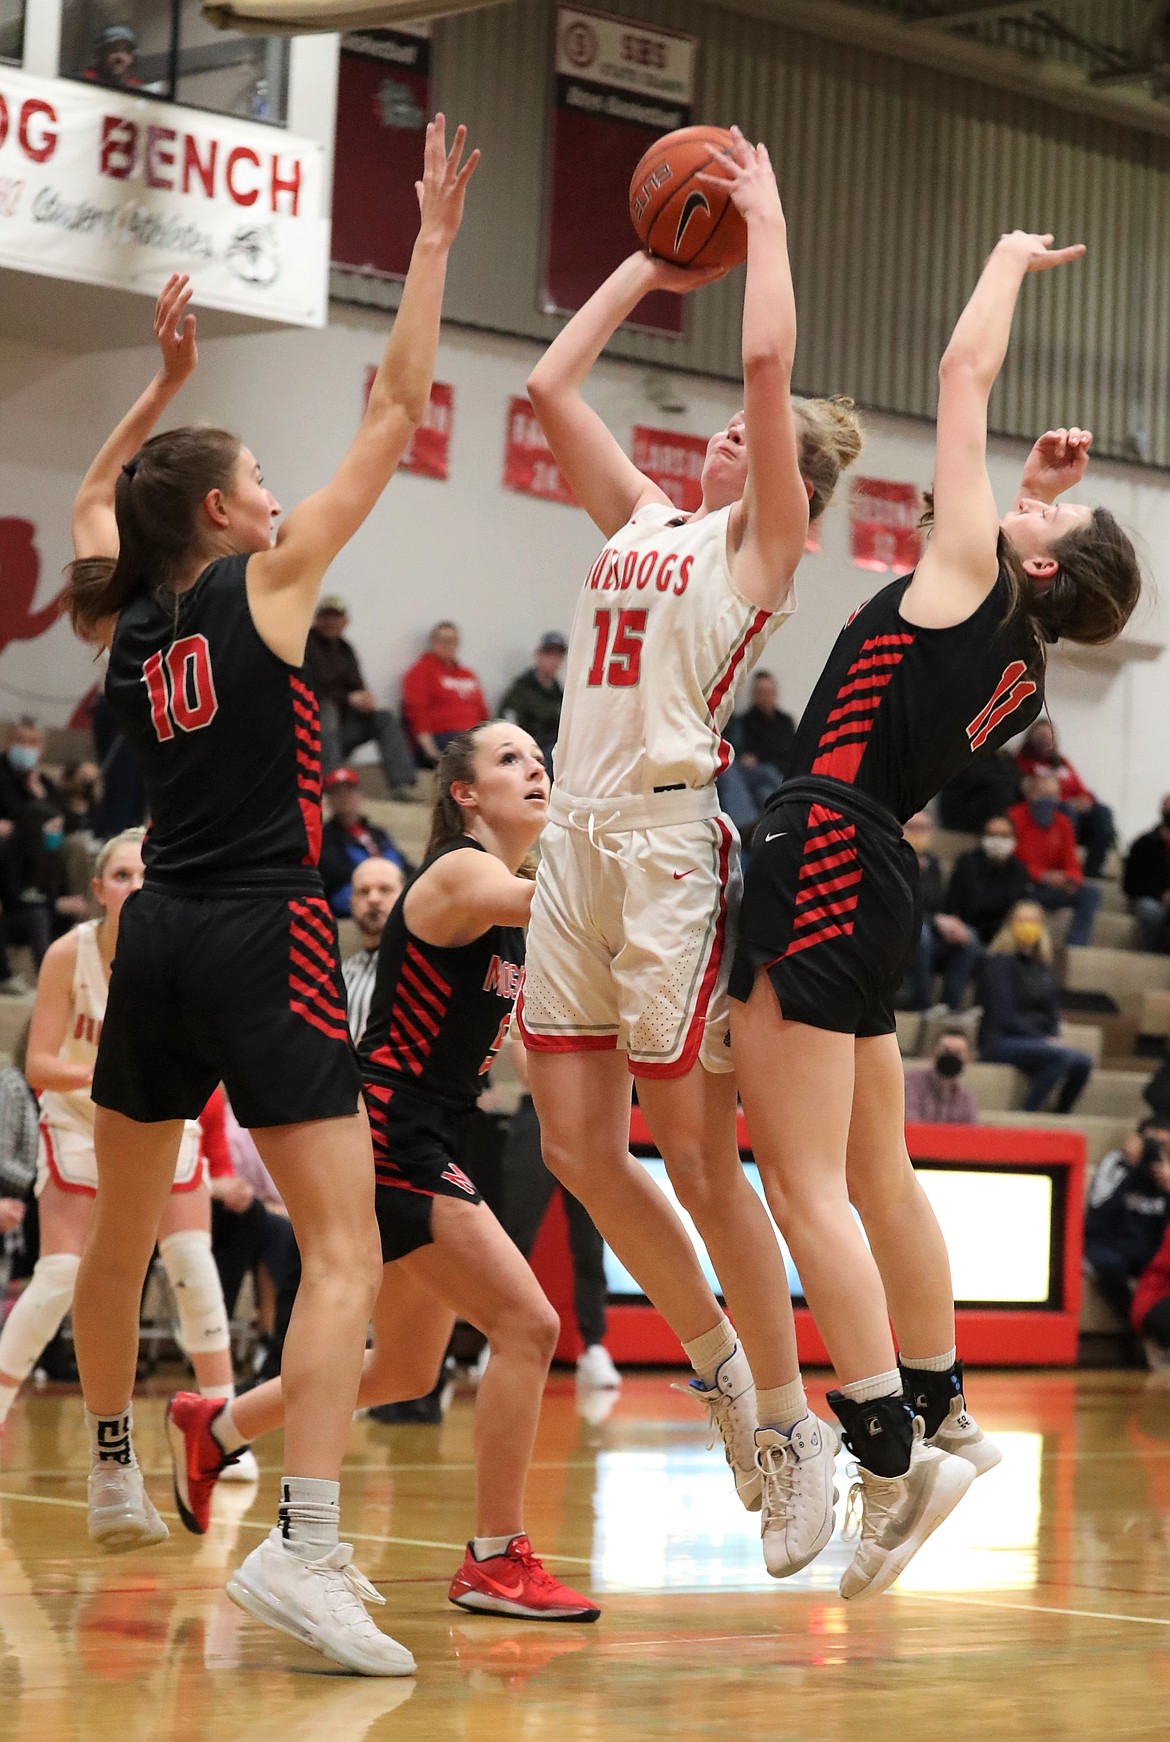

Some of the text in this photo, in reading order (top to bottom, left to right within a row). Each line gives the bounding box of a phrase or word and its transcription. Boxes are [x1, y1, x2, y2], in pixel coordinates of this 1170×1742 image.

[0, 93, 58, 163] G
[99, 115, 302, 217] BENCH
[584, 549, 695, 596] ULLDOGS
[140, 633, 219, 742] 10
[586, 608, 649, 688] 15
[965, 660, 1037, 753] 11
